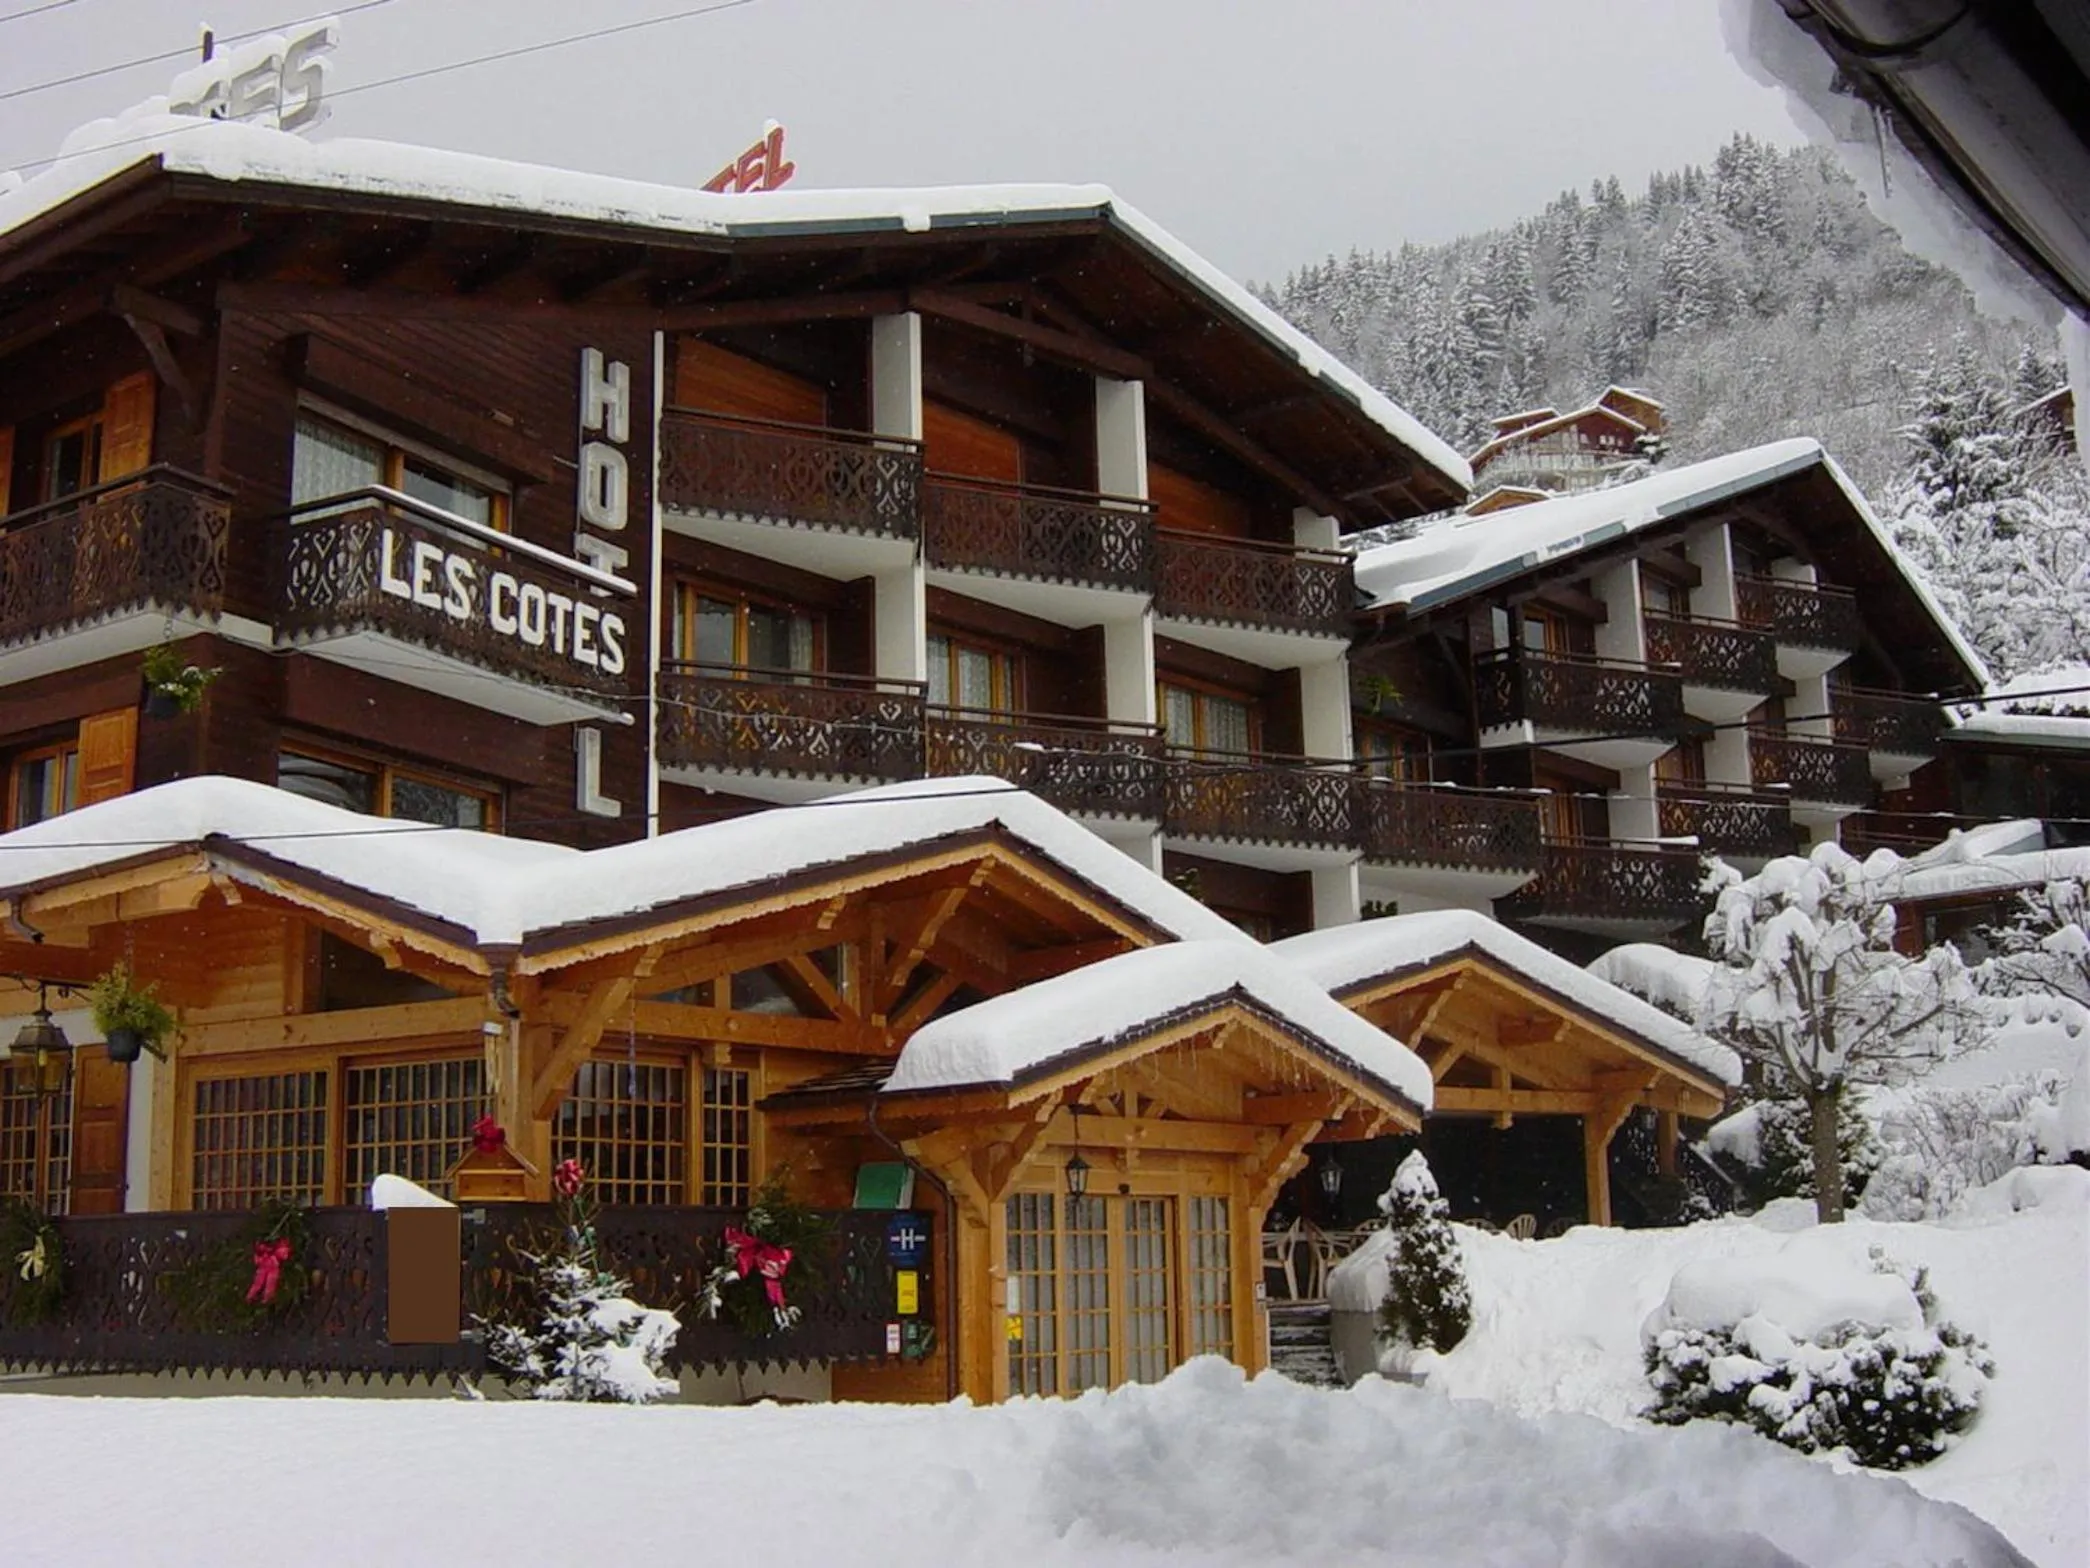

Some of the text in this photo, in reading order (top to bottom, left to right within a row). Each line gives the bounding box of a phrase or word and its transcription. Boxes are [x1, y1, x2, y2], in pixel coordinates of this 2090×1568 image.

[379, 528, 626, 676] LES COTES
[576, 346, 630, 818] HOTL
